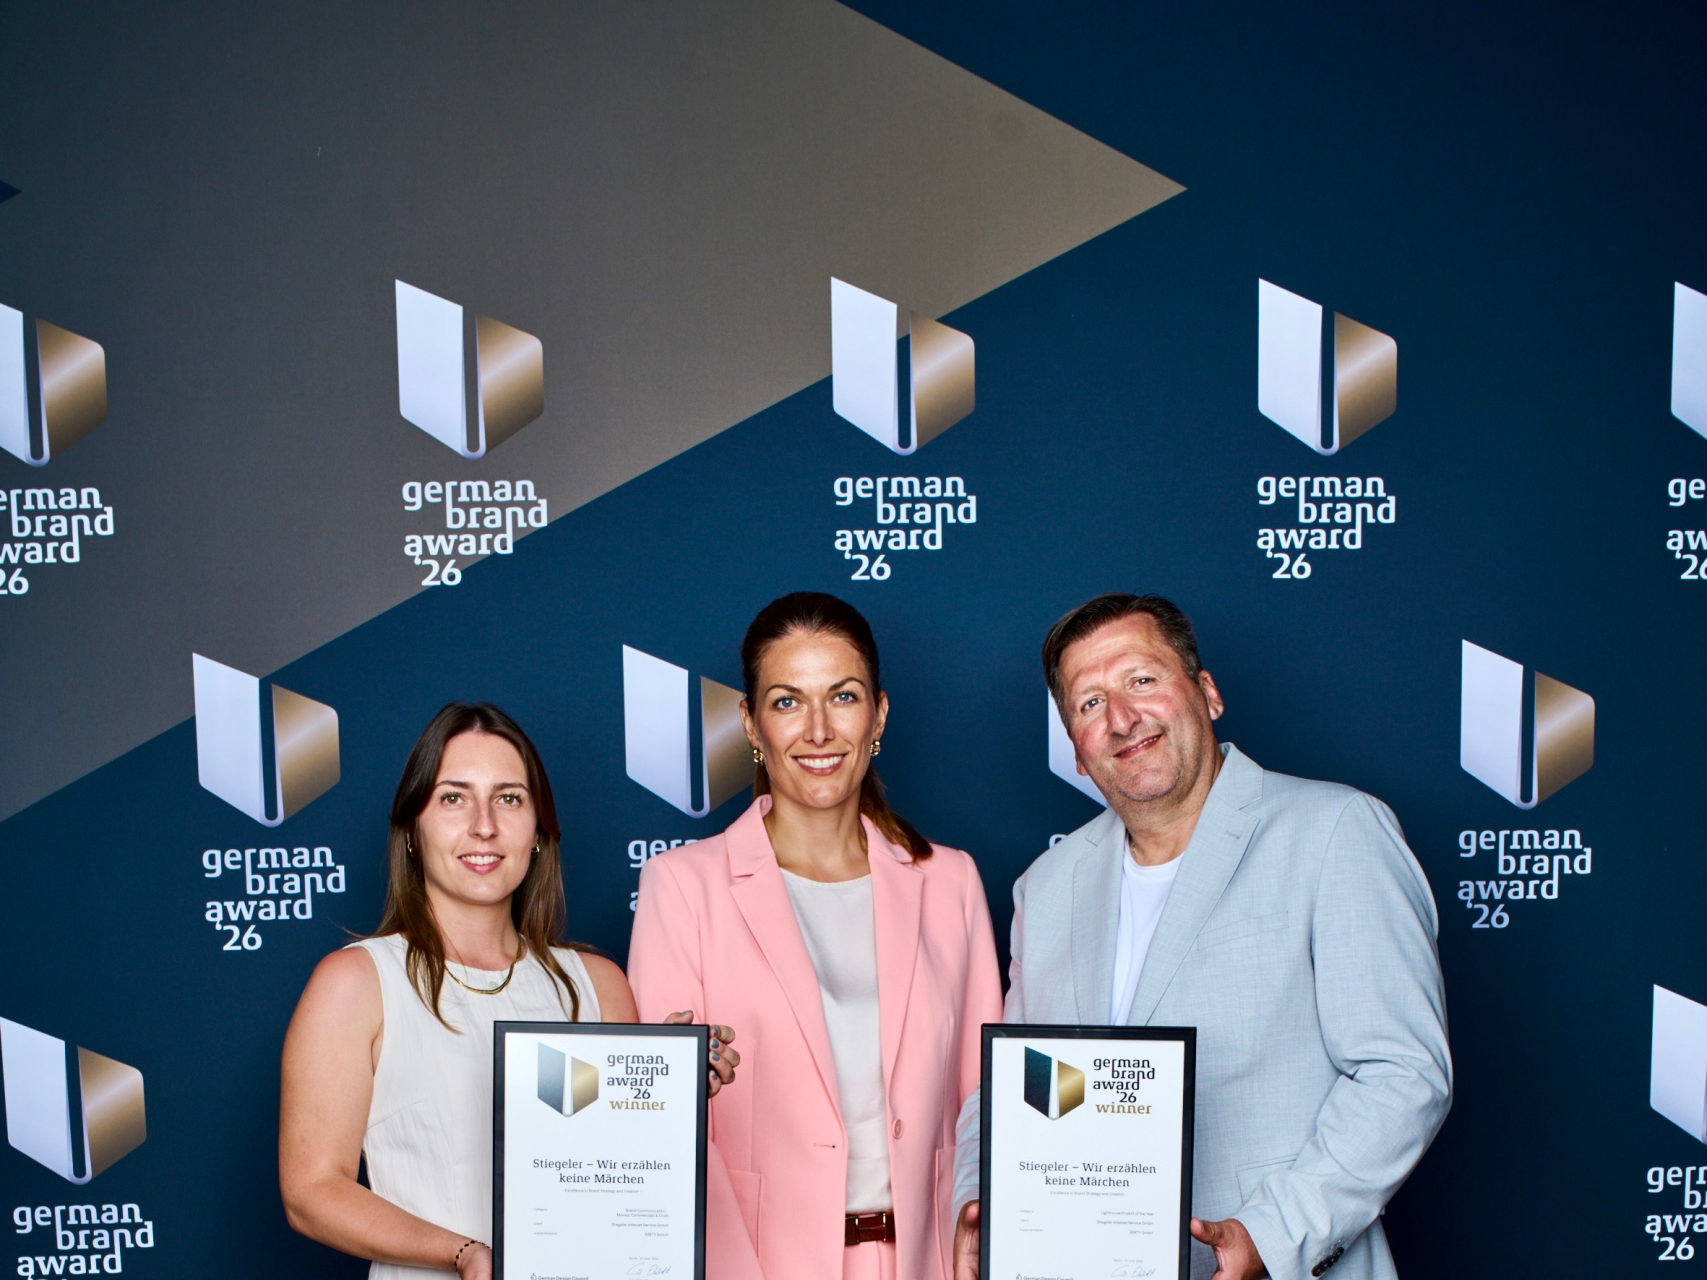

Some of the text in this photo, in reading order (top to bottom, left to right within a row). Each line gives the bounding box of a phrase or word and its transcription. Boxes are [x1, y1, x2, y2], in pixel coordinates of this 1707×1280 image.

[402, 480, 537, 510] german
[834, 476, 966, 506] german
[1257, 476, 1386, 505] german
[446, 499, 548, 528] brand
[877, 496, 976, 524] brand
[1299, 496, 1395, 523] brand
[11, 506, 114, 537] brand
[404, 534, 513, 556] award
[834, 529, 942, 550] award
[1257, 528, 1361, 549] award
[1458, 830, 1582, 857] german
[203, 846, 335, 878] german
[1498, 848, 1591, 875] brand
[247, 865, 346, 895] brand
[1458, 879, 1558, 900] award
[205, 899, 312, 922] award
[607, 1054, 664, 1067] german
[626, 1064, 669, 1076] brand
[1093, 1058, 1150, 1070] german
[607, 1077, 653, 1086] award
[1112, 1068, 1155, 1079] brand
[1093, 1081, 1140, 1090] award
[610, 1098, 666, 1110] winner
[1095, 1102, 1152, 1114] winner
[533, 1158, 583, 1171] Stiegeler
[597, 1160, 617, 1170] Wir
[621, 1160, 671, 1170] erzählen
[1019, 1162, 1068, 1173] Stiegeler
[1082, 1163, 1103, 1172] Wir
[1107, 1164, 1156, 1173] erzählen
[559, 1173, 644, 1184] keine Märchen
[1045, 1176, 1130, 1187] keine Märchen
[13, 1203, 143, 1234] german
[56, 1221, 154, 1250] brand
[17, 1254, 122, 1276] award
